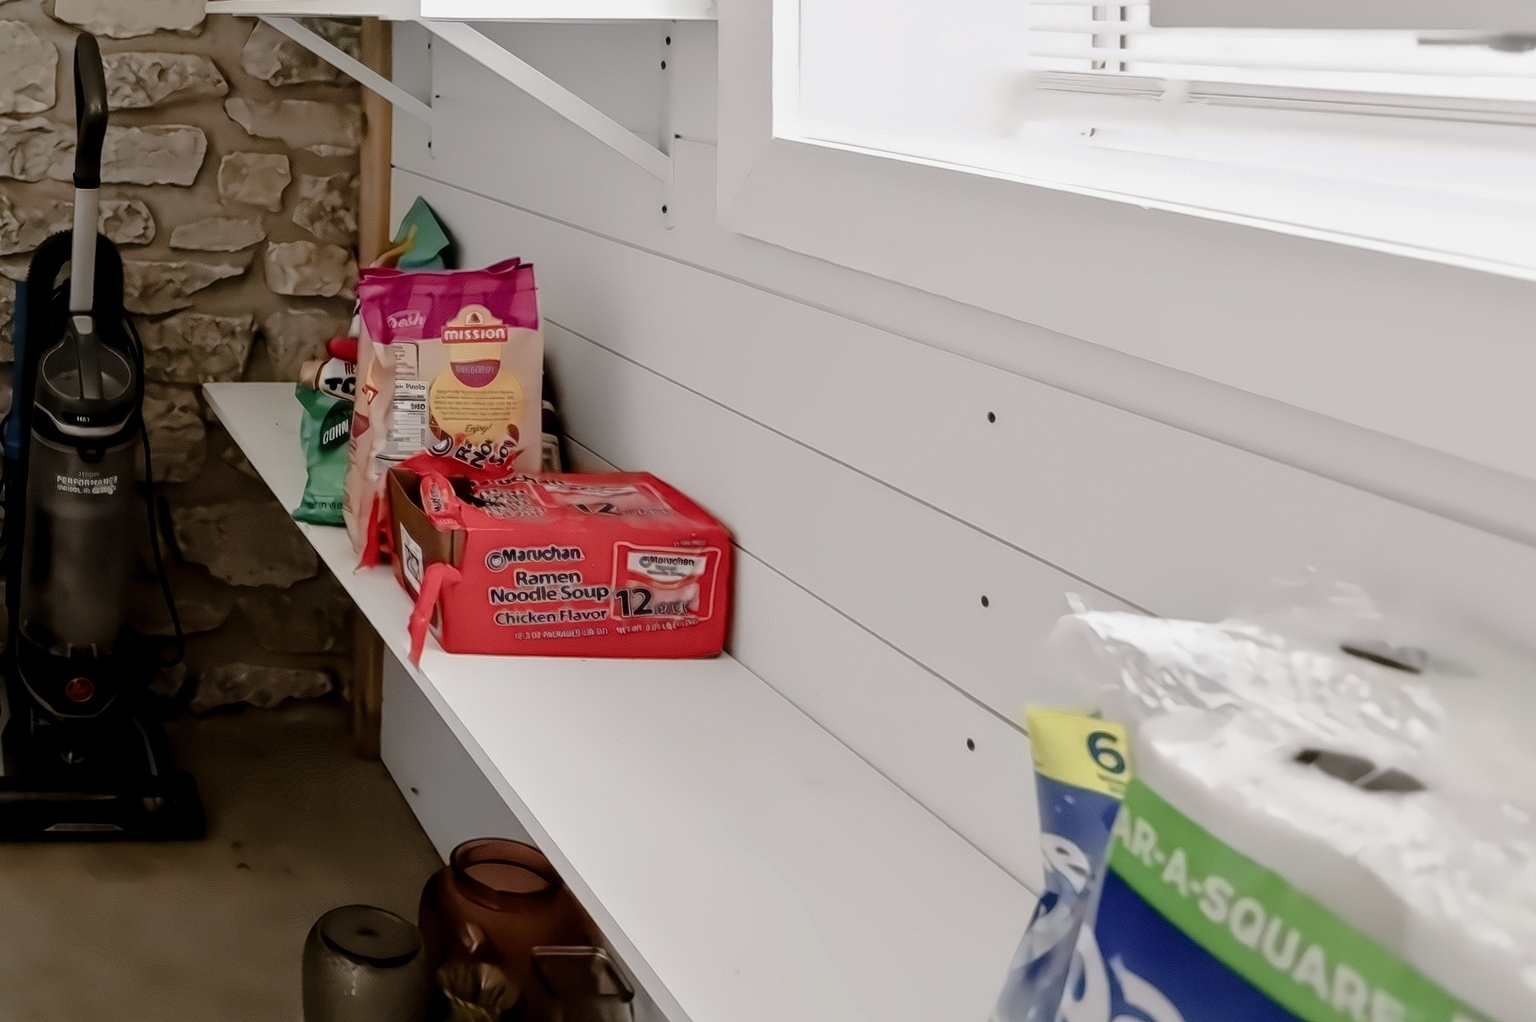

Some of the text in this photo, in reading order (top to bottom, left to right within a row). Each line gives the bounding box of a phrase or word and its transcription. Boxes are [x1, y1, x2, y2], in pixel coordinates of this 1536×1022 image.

[502, 546, 582, 563] Maruchan
[515, 571, 581, 586] Ramen
[490, 586, 610, 604] Noodle Soup
[615, 588, 653, 617] 12
[495, 609, 607, 625] Chicken Flavor
[1086, 731, 1126, 774] 6
